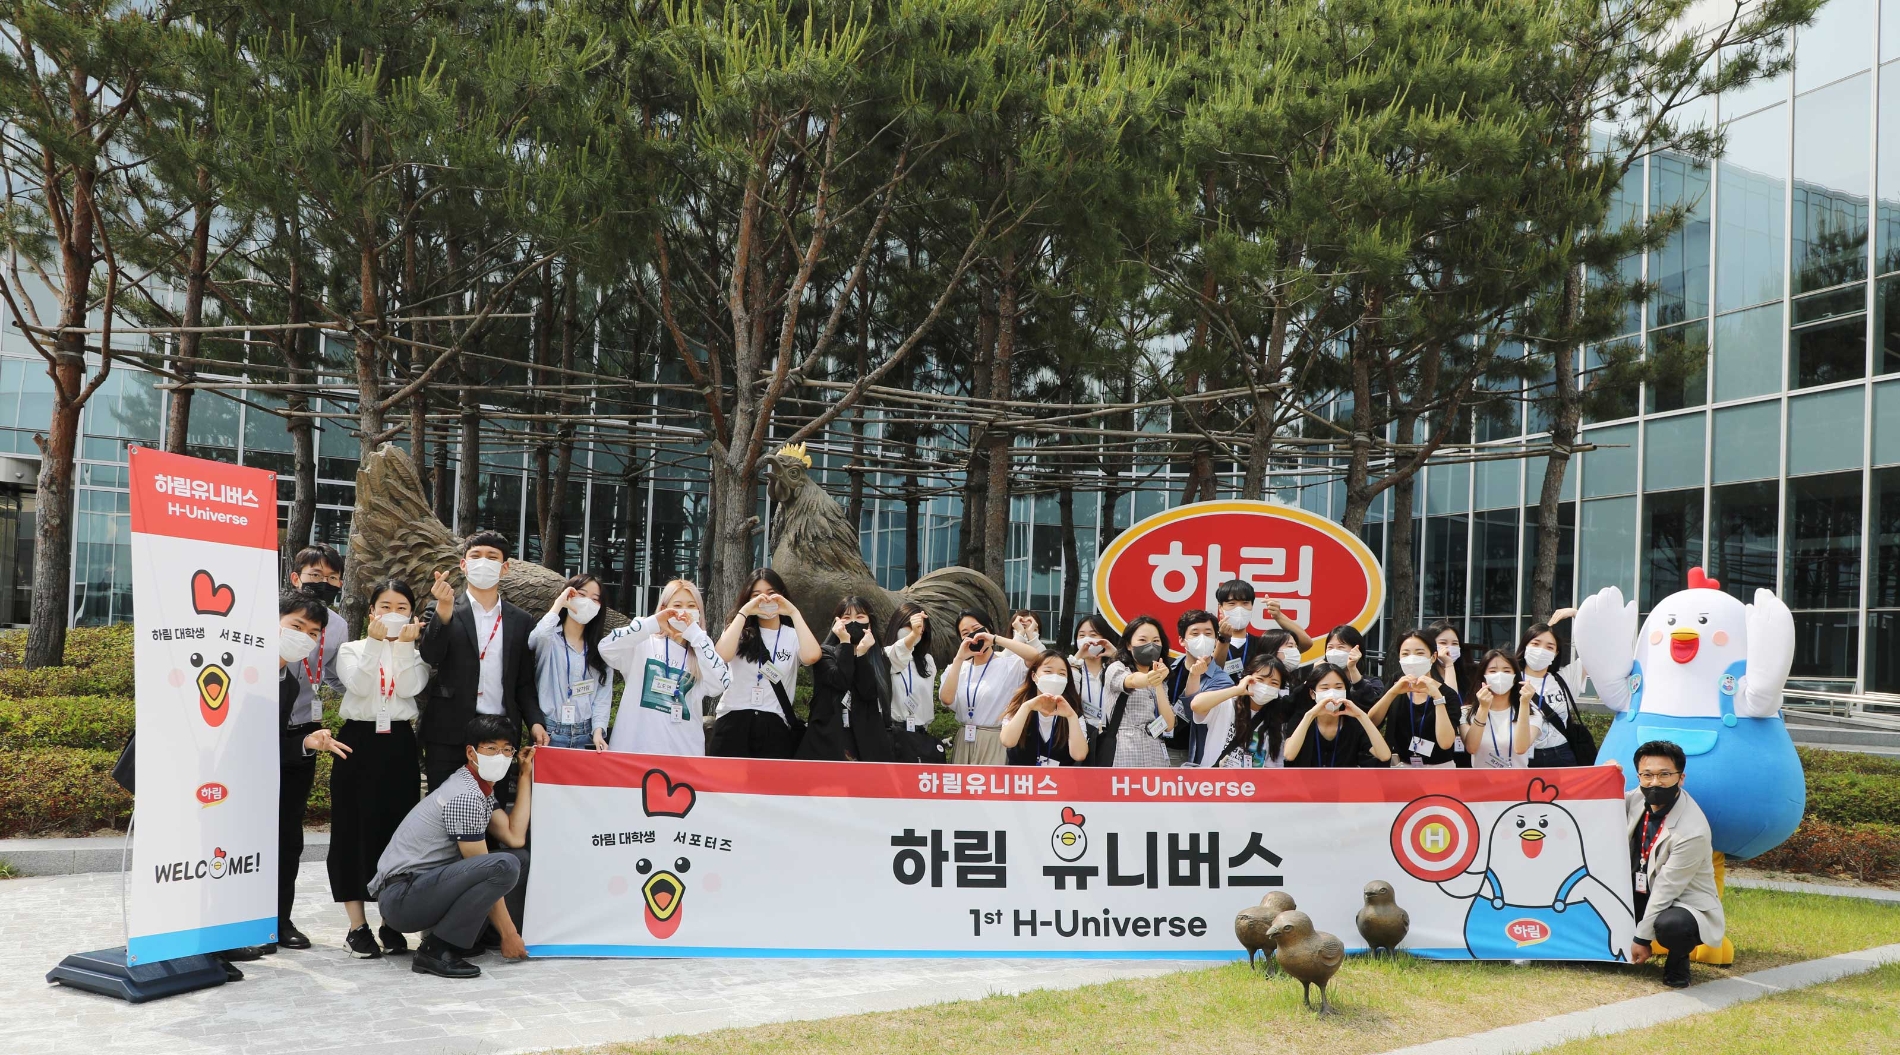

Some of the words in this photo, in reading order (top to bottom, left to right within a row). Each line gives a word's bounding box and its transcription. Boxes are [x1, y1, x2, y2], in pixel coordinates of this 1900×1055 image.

[154, 474, 259, 508] 하림유니버스
[167, 502, 248, 526] H-Universe
[1148, 541, 1313, 630] 하림
[152, 628, 173, 641] 하림
[174, 627, 205, 640] 대학생
[219, 628, 265, 648] 서포터즈
[201, 787, 222, 800] 하림
[918, 772, 1058, 796] 하림유니버스
[1112, 775, 1256, 797] H-Universe
[591, 833, 616, 848] 하림
[618, 830, 656, 846] 대학생
[673, 831, 732, 852] 서포터즈
[1425, 828, 1444, 848] H
[155, 850, 261, 884] WELCOME!
[891, 828, 1007, 888] 하림
[1043, 822, 1284, 891] 유니버스
[969, 908, 1003, 937] 1st
[1014, 908, 1207, 938] H-Universe
[1513, 924, 1541, 939] 하림
